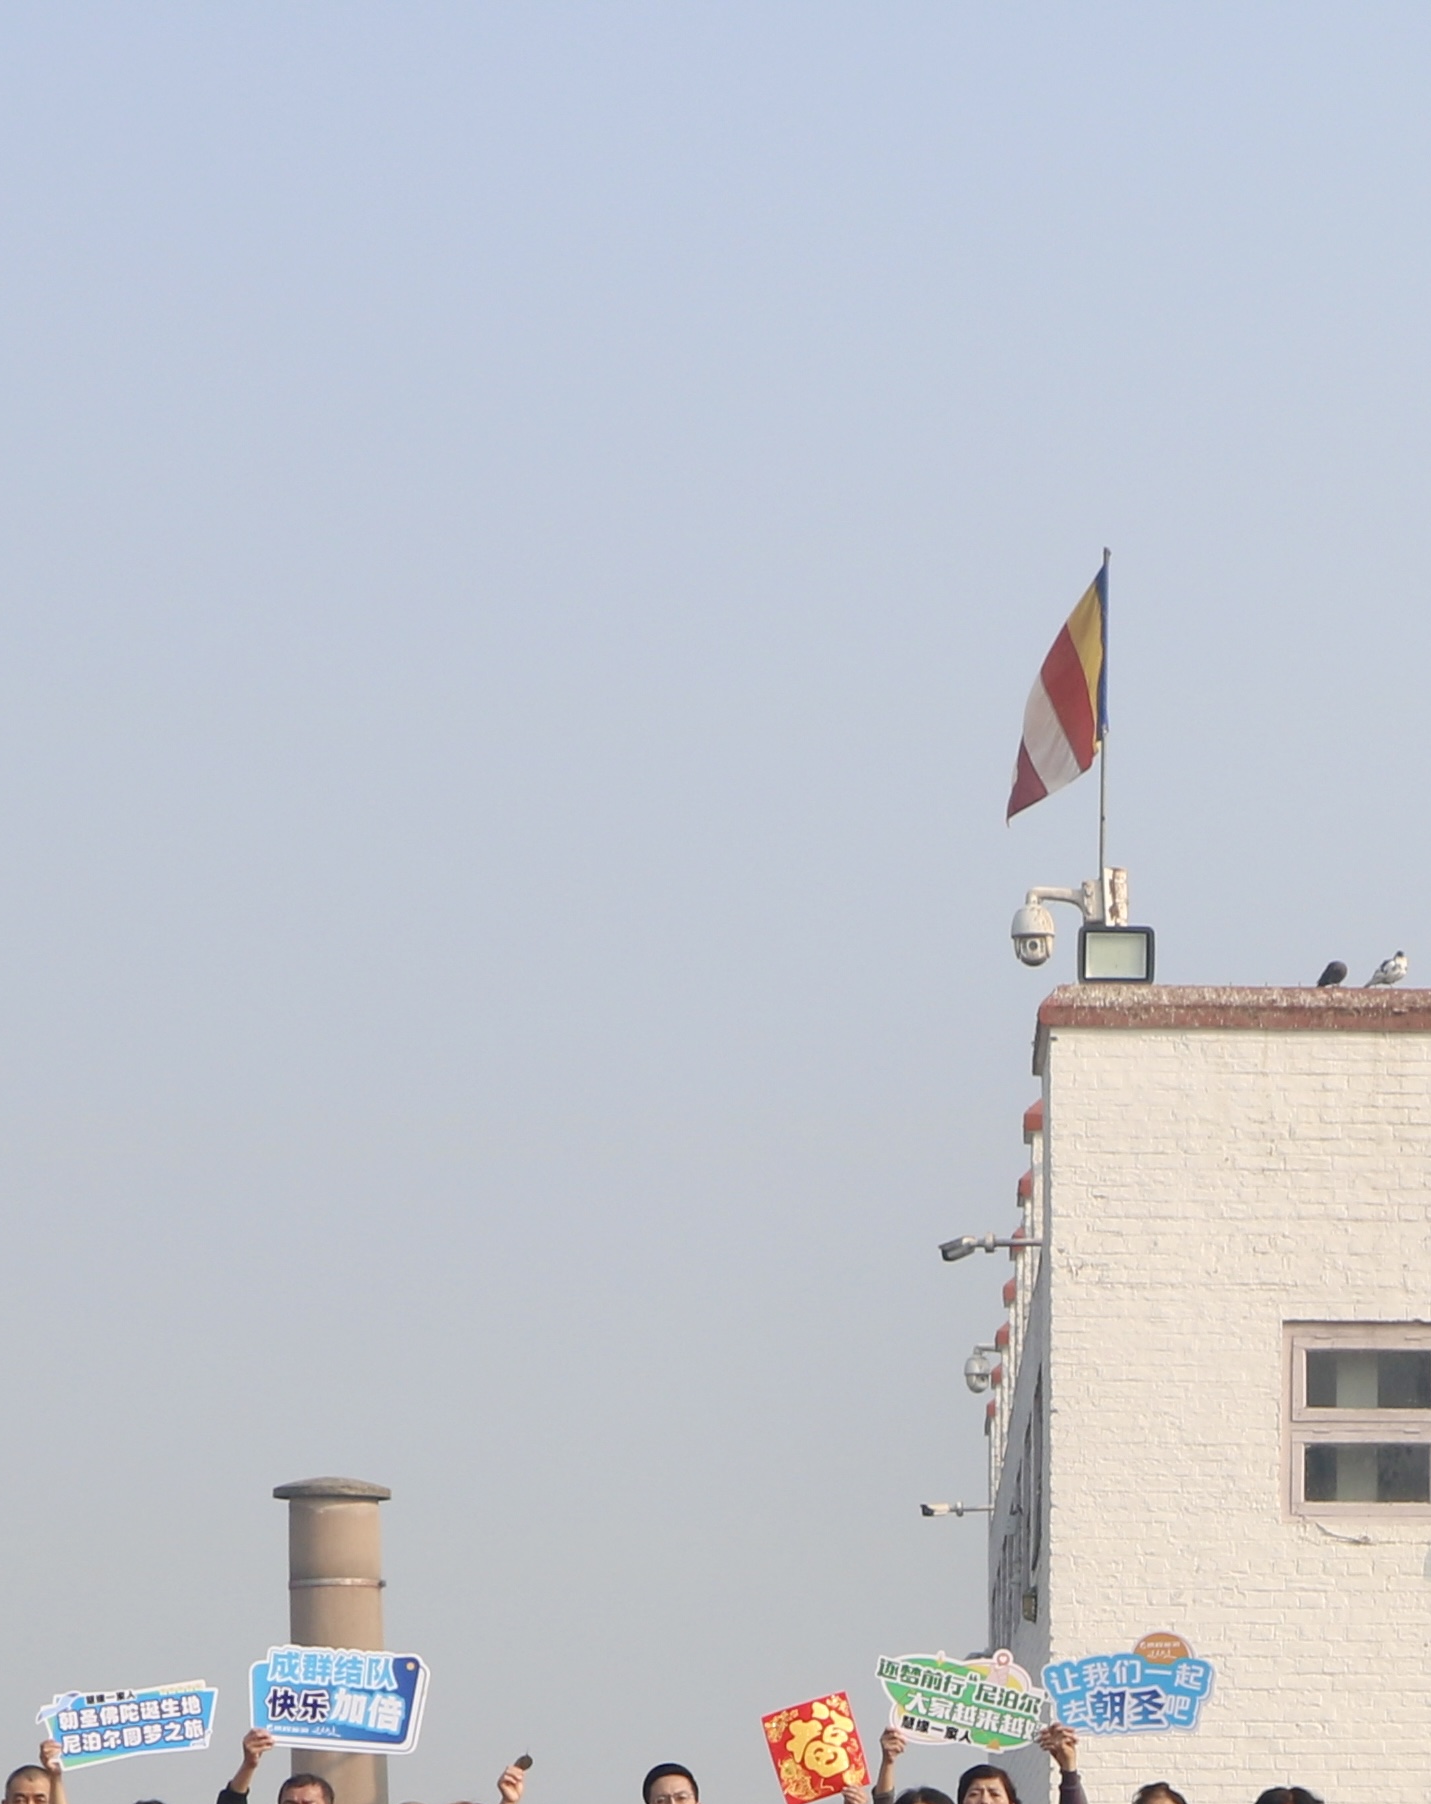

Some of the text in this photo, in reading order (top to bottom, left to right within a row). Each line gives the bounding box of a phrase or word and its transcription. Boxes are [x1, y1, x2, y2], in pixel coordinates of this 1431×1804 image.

[269, 1650, 398, 1691] 成群结队
[1050, 1659, 1205, 1695] 让我们一起
[58, 1695, 202, 1732] 朝圣佛陀诞生地
[266, 1687, 404, 1733] 快乐加倍
[1062, 1688, 1191, 1729] 去朝圣吧
[61, 1719, 204, 1755] 尼泊尔圆梦之旅
[786, 1701, 854, 1778] 福
